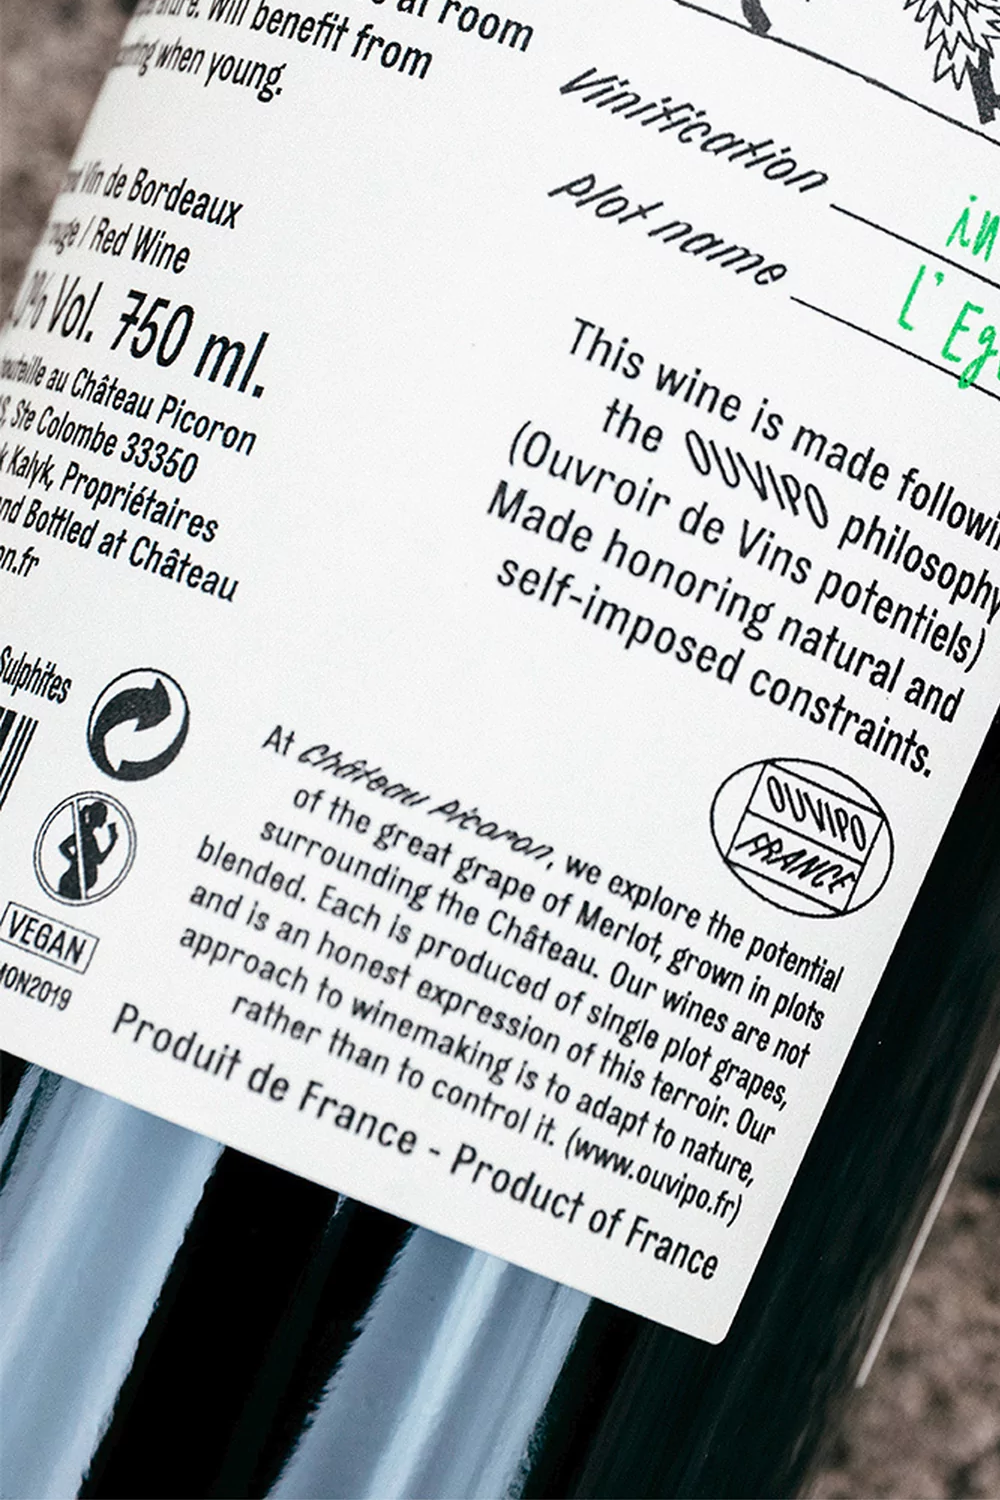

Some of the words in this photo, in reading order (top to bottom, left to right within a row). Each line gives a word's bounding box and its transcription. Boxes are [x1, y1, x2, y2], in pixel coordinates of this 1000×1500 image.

[155, 36, 205, 75] when
[204, 52, 287, 103] young.
[351, 24, 432, 79] from
[438, 0, 533, 52] room
[559, 67, 828, 193] Vinification
[90, 217, 133, 256] Red
[131, 225, 190, 274] Wine
[103, 164, 127, 199] de
[127, 168, 243, 229] Bordeaux
[548, 174, 664, 224] plot
[648, 221, 787, 285] name
[946, 194, 1000, 263] in
[47, 274, 104, 343] Vol.
[110, 289, 195, 367] 750
[193, 332, 269, 398] ml.
[10, 398, 36, 432] Ste
[37, 406, 118, 456] Colombe
[121, 432, 199, 483] 33350
[46, 369, 70, 393] au
[71, 368, 154, 419] Château
[156, 394, 257, 456] Picoron
[570, 317, 644, 379] This
[656, 364, 741, 422] wine
[751, 398, 783, 441] is
[791, 426, 889, 490] made
[7, 444, 55, 492] Kalyk,
[60, 461, 219, 542] Propriétaires
[603, 398, 663, 452] the
[685, 430, 828, 529] OUVIPO
[22, 499, 100, 549] Bottled
[97, 529, 127, 559] at
[129, 536, 239, 602] Château
[487, 480, 593, 552] Made
[602, 528, 776, 642] honoring
[778, 616, 905, 693] natural
[904, 677, 965, 723] and
[509, 421, 671, 517] (Ouvroir
[679, 501, 724, 544] de
[739, 519, 812, 584] Vins
[815, 570, 985, 673] potentiels)
[0, 644, 73, 705] Sulphites
[497, 559, 745, 684] self-imposed
[750, 669, 931, 778] constraints.
[262, 725, 295, 756] At
[298, 744, 430, 807] Château
[428, 800, 554, 870] Picoron,
[566, 855, 601, 885] we
[608, 875, 701, 929] explore
[707, 910, 745, 948] the
[745, 936, 844, 992] potential
[735, 832, 858, 895] FRANCE
[767, 775, 867, 852] OUVIPO
[9, 910, 88, 965] VEGAN
[260, 821, 432, 912] surrounding
[437, 888, 479, 925] the
[488, 910, 598, 978] Château.
[610, 961, 657, 999] Our
[663, 989, 728, 1033] wines
[731, 1021, 770, 1051] are
[772, 1038, 810, 1068] not
[294, 789, 325, 813] of
[328, 796, 371, 834] the
[373, 824, 452, 867] great
[452, 857, 535, 902] grape
[542, 893, 574, 917] of
[576, 900, 662, 963] Merlot,
[666, 947, 744, 995] grown
[748, 975, 770, 1006] in
[770, 992, 825, 1030] plots
[190, 886, 243, 919] and
[246, 901, 269, 931] is
[276, 921, 310, 948] an
[317, 931, 411, 989] honest
[417, 980, 560, 1053] expression
[567, 1043, 597, 1067] of
[599, 1049, 645, 1089] this
[651, 1071, 729, 1127] terroir.
[736, 1108, 776, 1144] Our
[197, 835, 305, 902] blended.
[317, 885, 381, 931] Each
[388, 914, 411, 944] is
[415, 934, 551, 1001] produced
[555, 991, 586, 1015] of
[587, 1004, 659, 1049] single
[660, 1037, 712, 1071] plot
[709, 1058, 786, 1111] grapes,
[180, 928, 308, 994] approach
[317, 977, 343, 1008] to
[352, 998, 513, 1086] winemaking
[515, 1060, 538, 1090] is
[545, 1073, 570, 1104] to
[576, 1093, 649, 1137] adapt
[653, 1117, 676, 1149] to
[680, 1136, 753, 1188] nature,
[232, 996, 321, 1044] rather
[329, 1028, 389, 1075] than
[398, 1057, 424, 1089] to
[432, 1079, 531, 1133] control
[534, 1114, 555, 1146] it.
[565, 1127, 742, 1228] (www.ouvipo.fr)
[112, 1003, 241, 1080] Produit
[248, 1063, 289, 1101] de
[299, 1080, 417, 1155] France
[450, 1143, 584, 1223] Product
[589, 1208, 626, 1239] of
[625, 1215, 718, 1279] France
